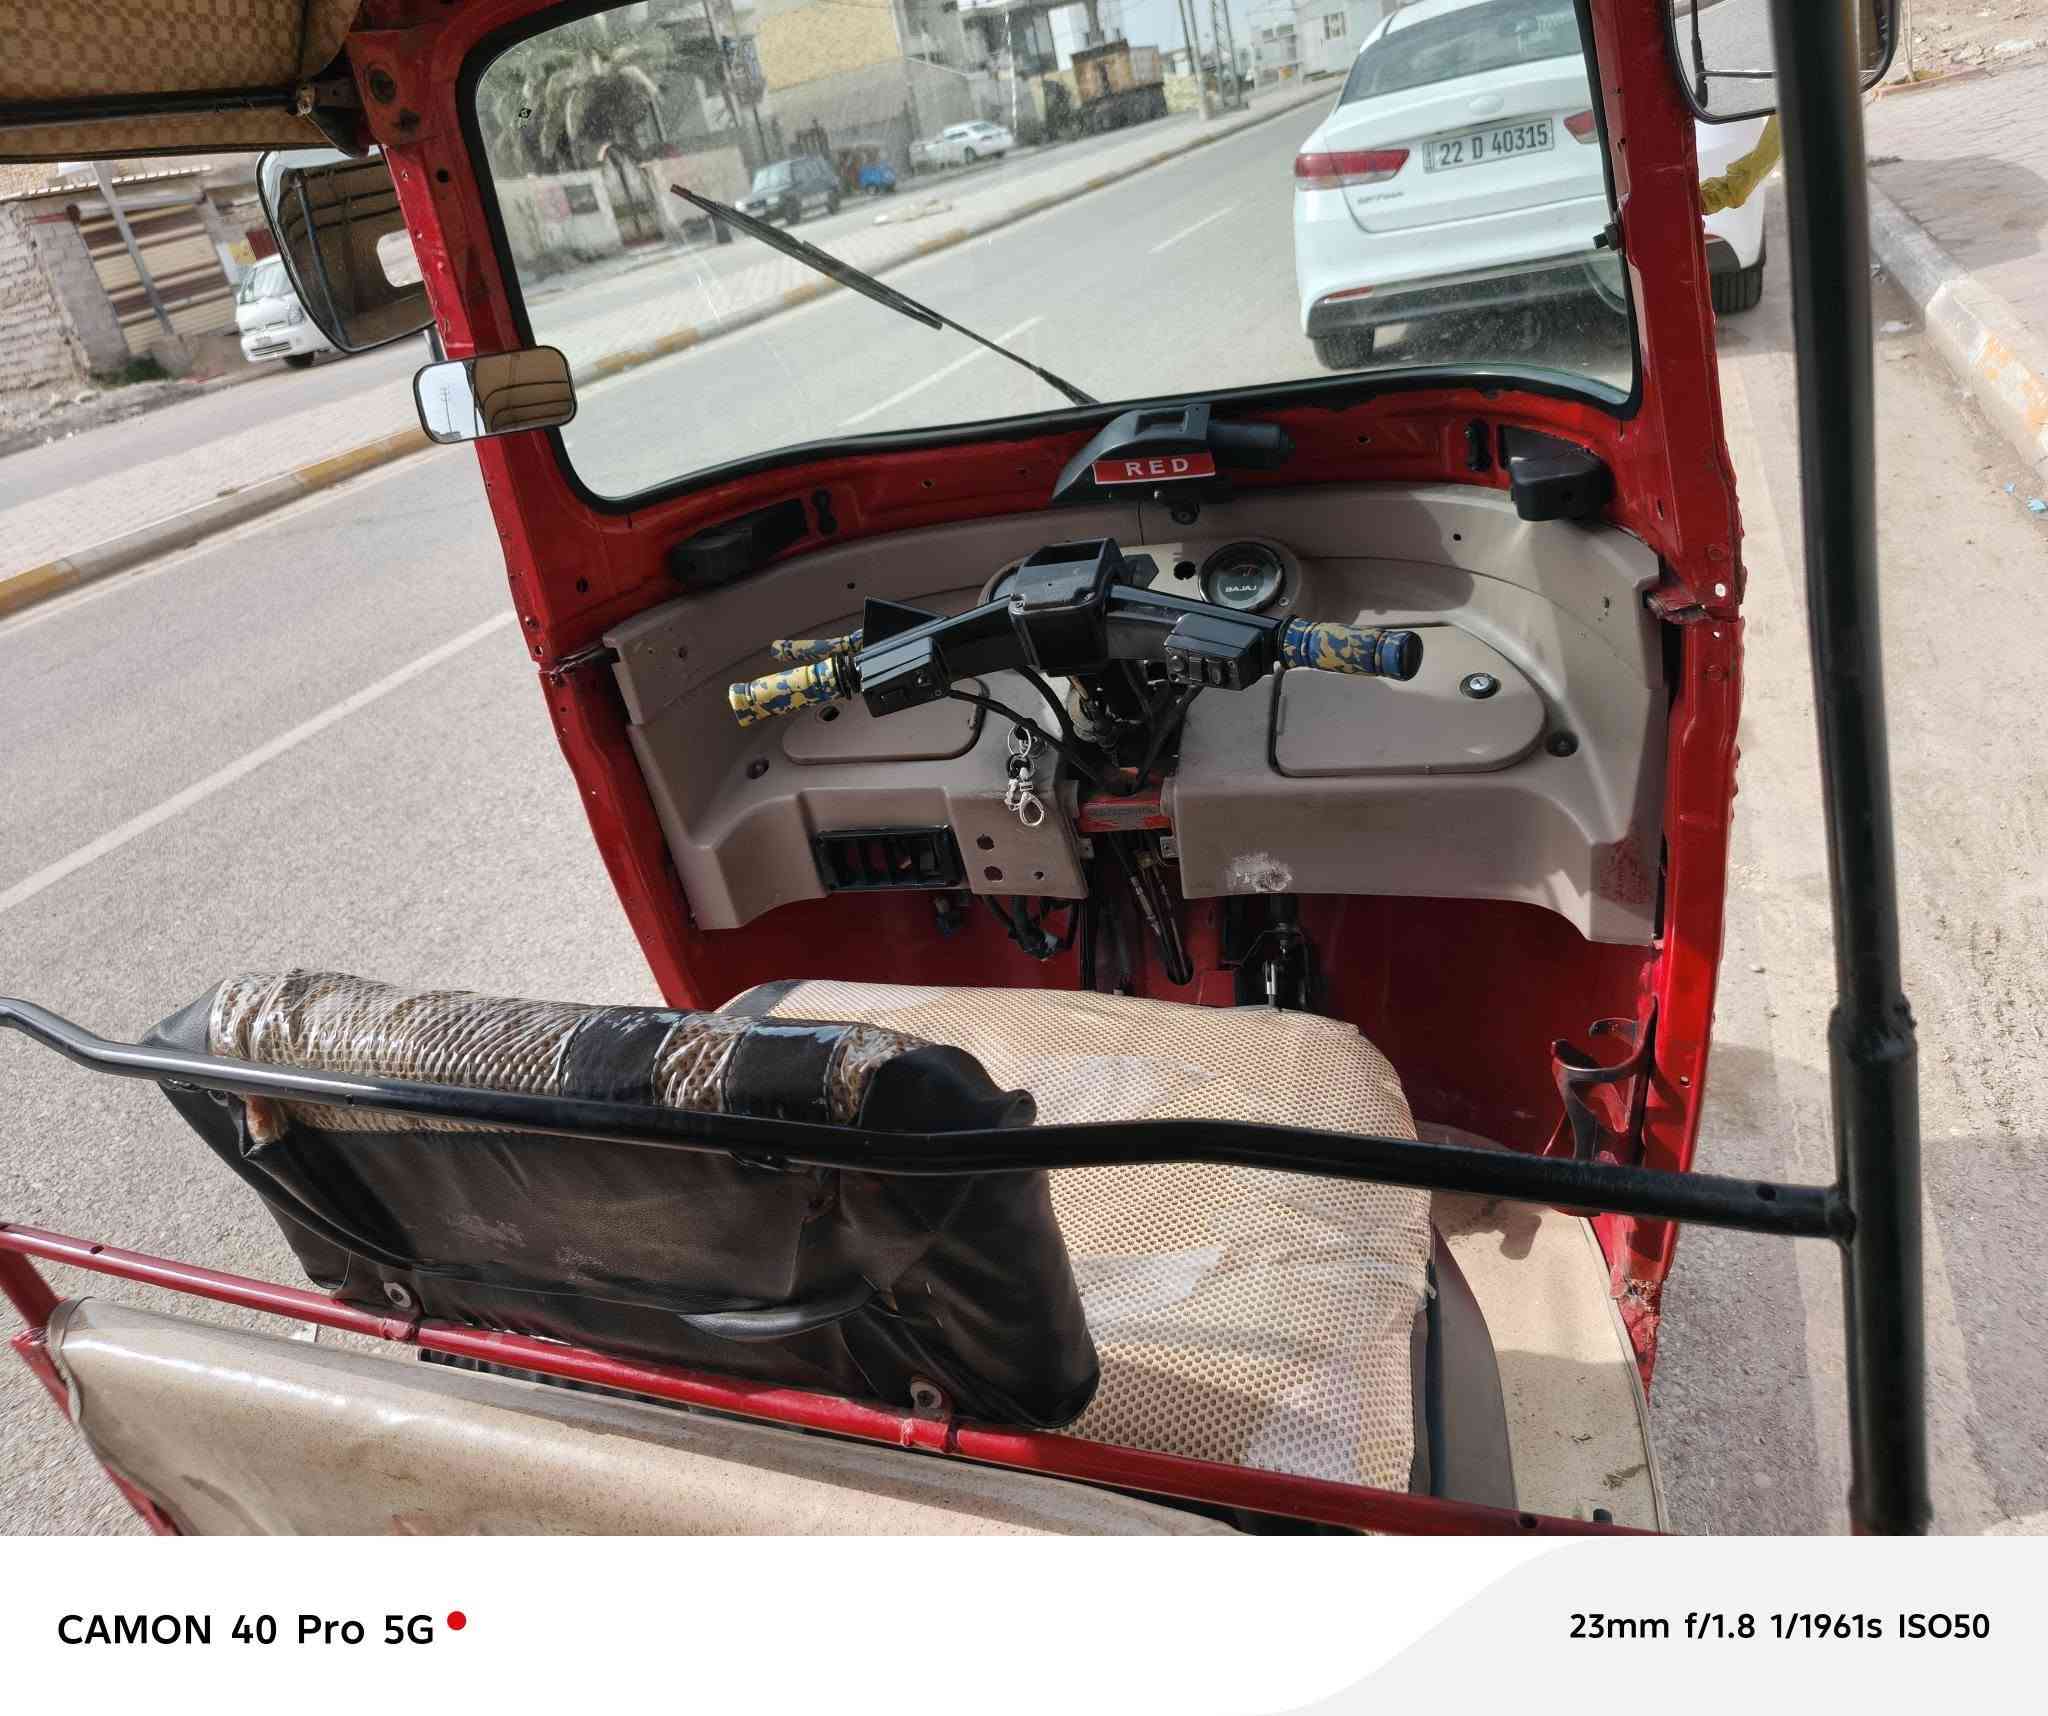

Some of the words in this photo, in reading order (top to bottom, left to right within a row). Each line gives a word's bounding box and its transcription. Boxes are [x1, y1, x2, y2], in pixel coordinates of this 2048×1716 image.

[1439, 140, 1464, 166] 22
[1471, 136, 1484, 160] D
[1491, 123, 1549, 155] 40315
[1124, 458, 1190, 477] RED
